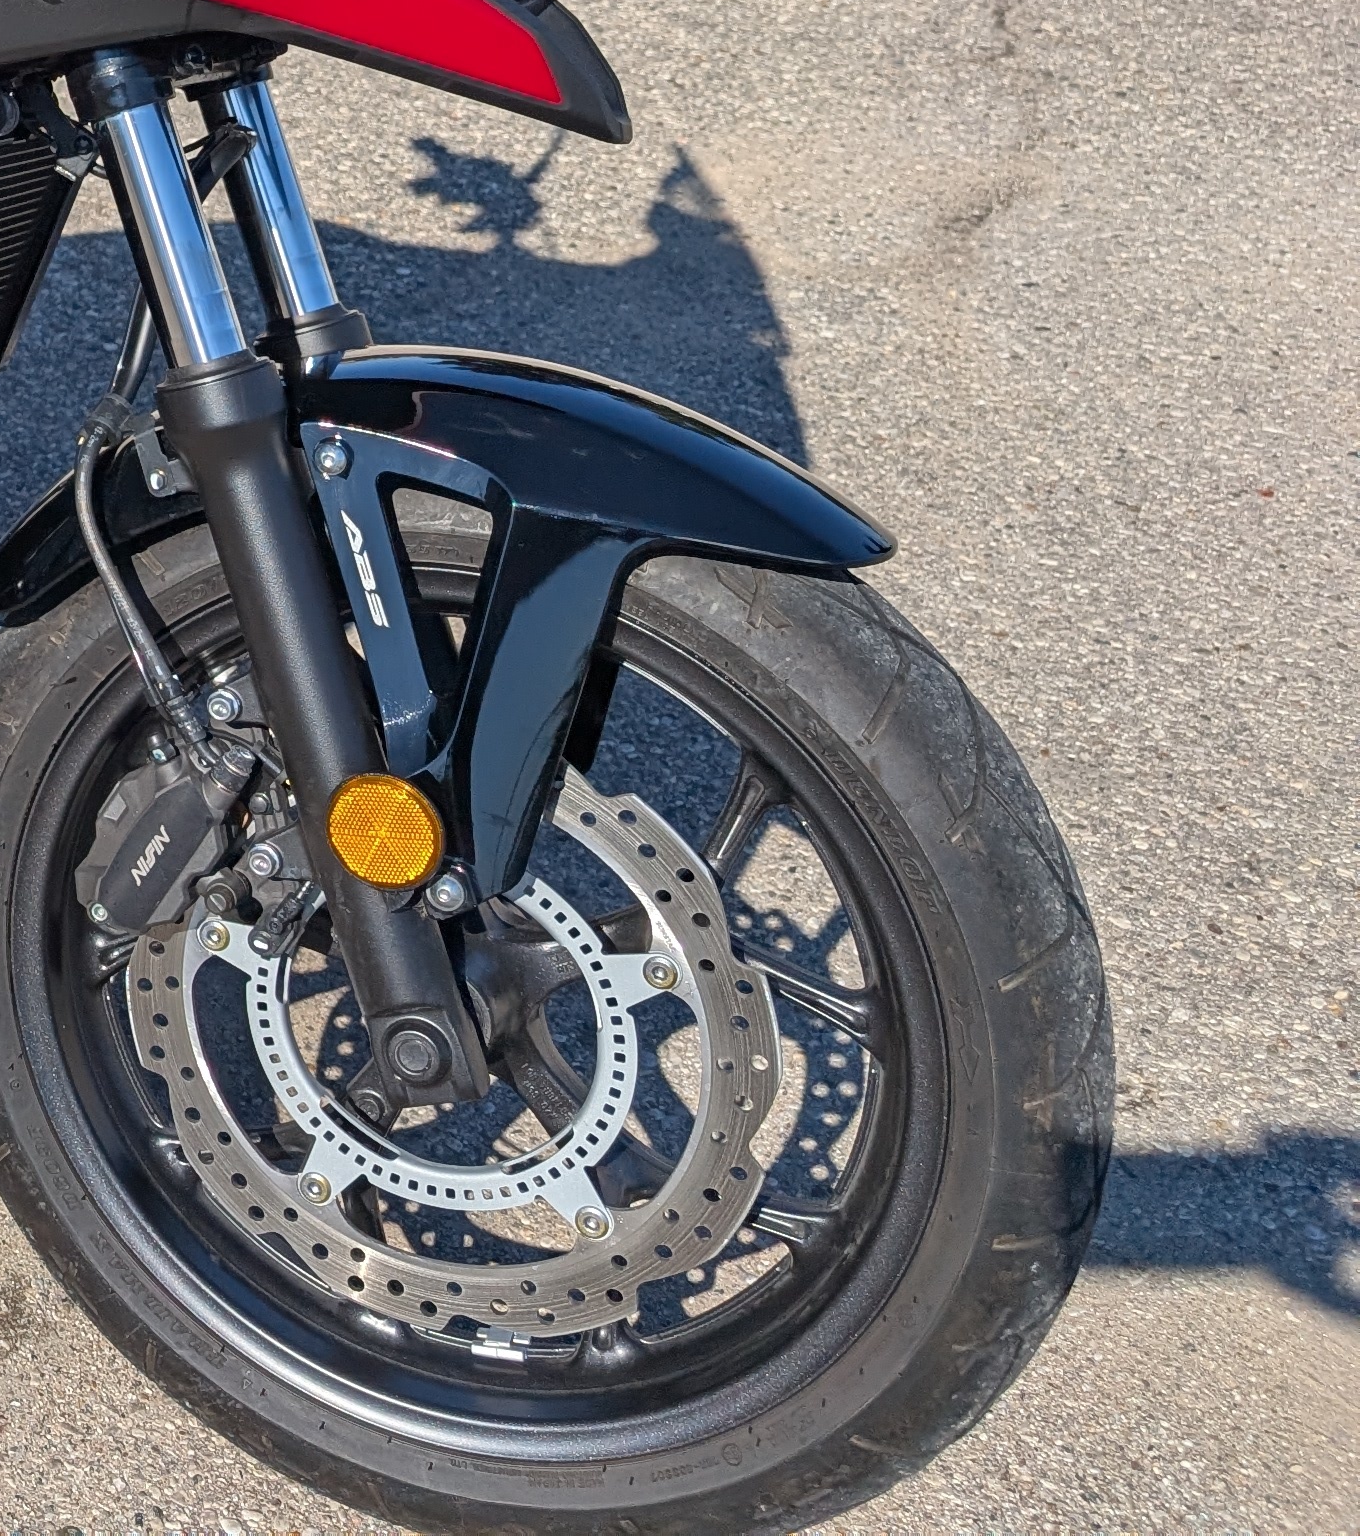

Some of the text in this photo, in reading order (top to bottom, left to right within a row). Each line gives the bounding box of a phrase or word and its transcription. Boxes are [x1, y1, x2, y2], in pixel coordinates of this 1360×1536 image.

[340, 509, 391, 629] ABS
[825, 748, 943, 914] DUNLOP
[88, 1229, 231, 1370] TRAILMAX
